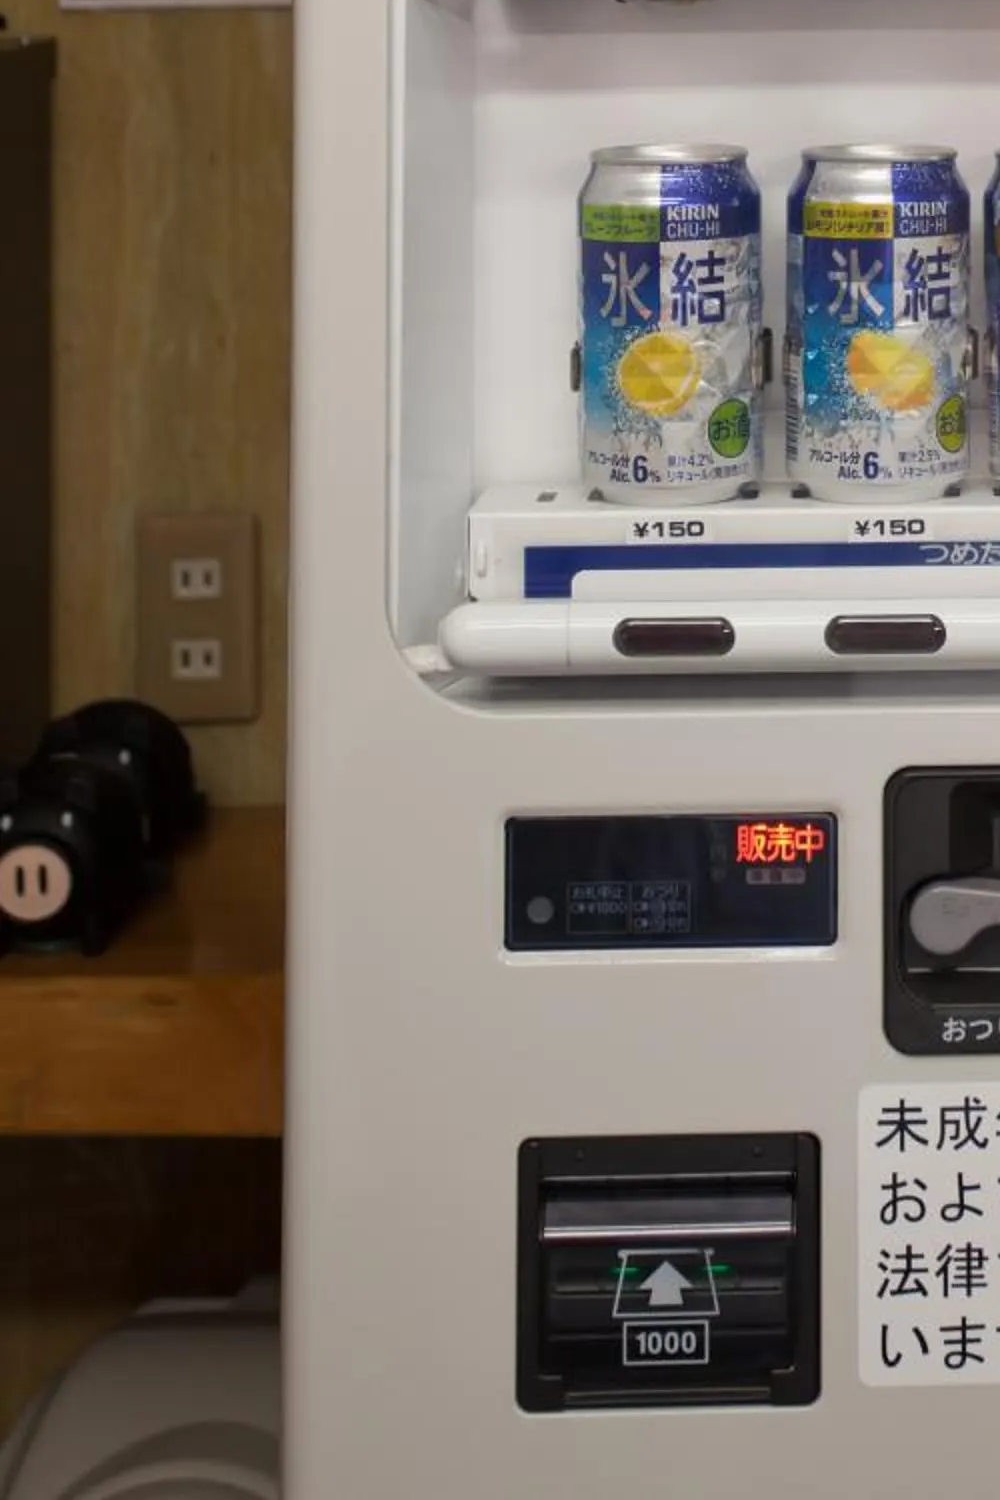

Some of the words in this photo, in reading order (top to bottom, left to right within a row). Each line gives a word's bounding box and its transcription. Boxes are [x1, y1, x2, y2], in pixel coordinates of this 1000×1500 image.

[667, 203, 720, 221] KIRIN
[900, 201, 948, 217] KIRIN
[667, 222, 721, 239] CHU-HI
[900, 217, 948, 235] CHU-HI
[600, 250, 727, 328] 氷結
[827, 246, 950, 325] 氷結
[634, 521, 705, 538] ¥150
[854, 519, 925, 536] ¥150
[736, 823, 825, 864] 販売中
[635, 1331, 697, 1355] 1000
